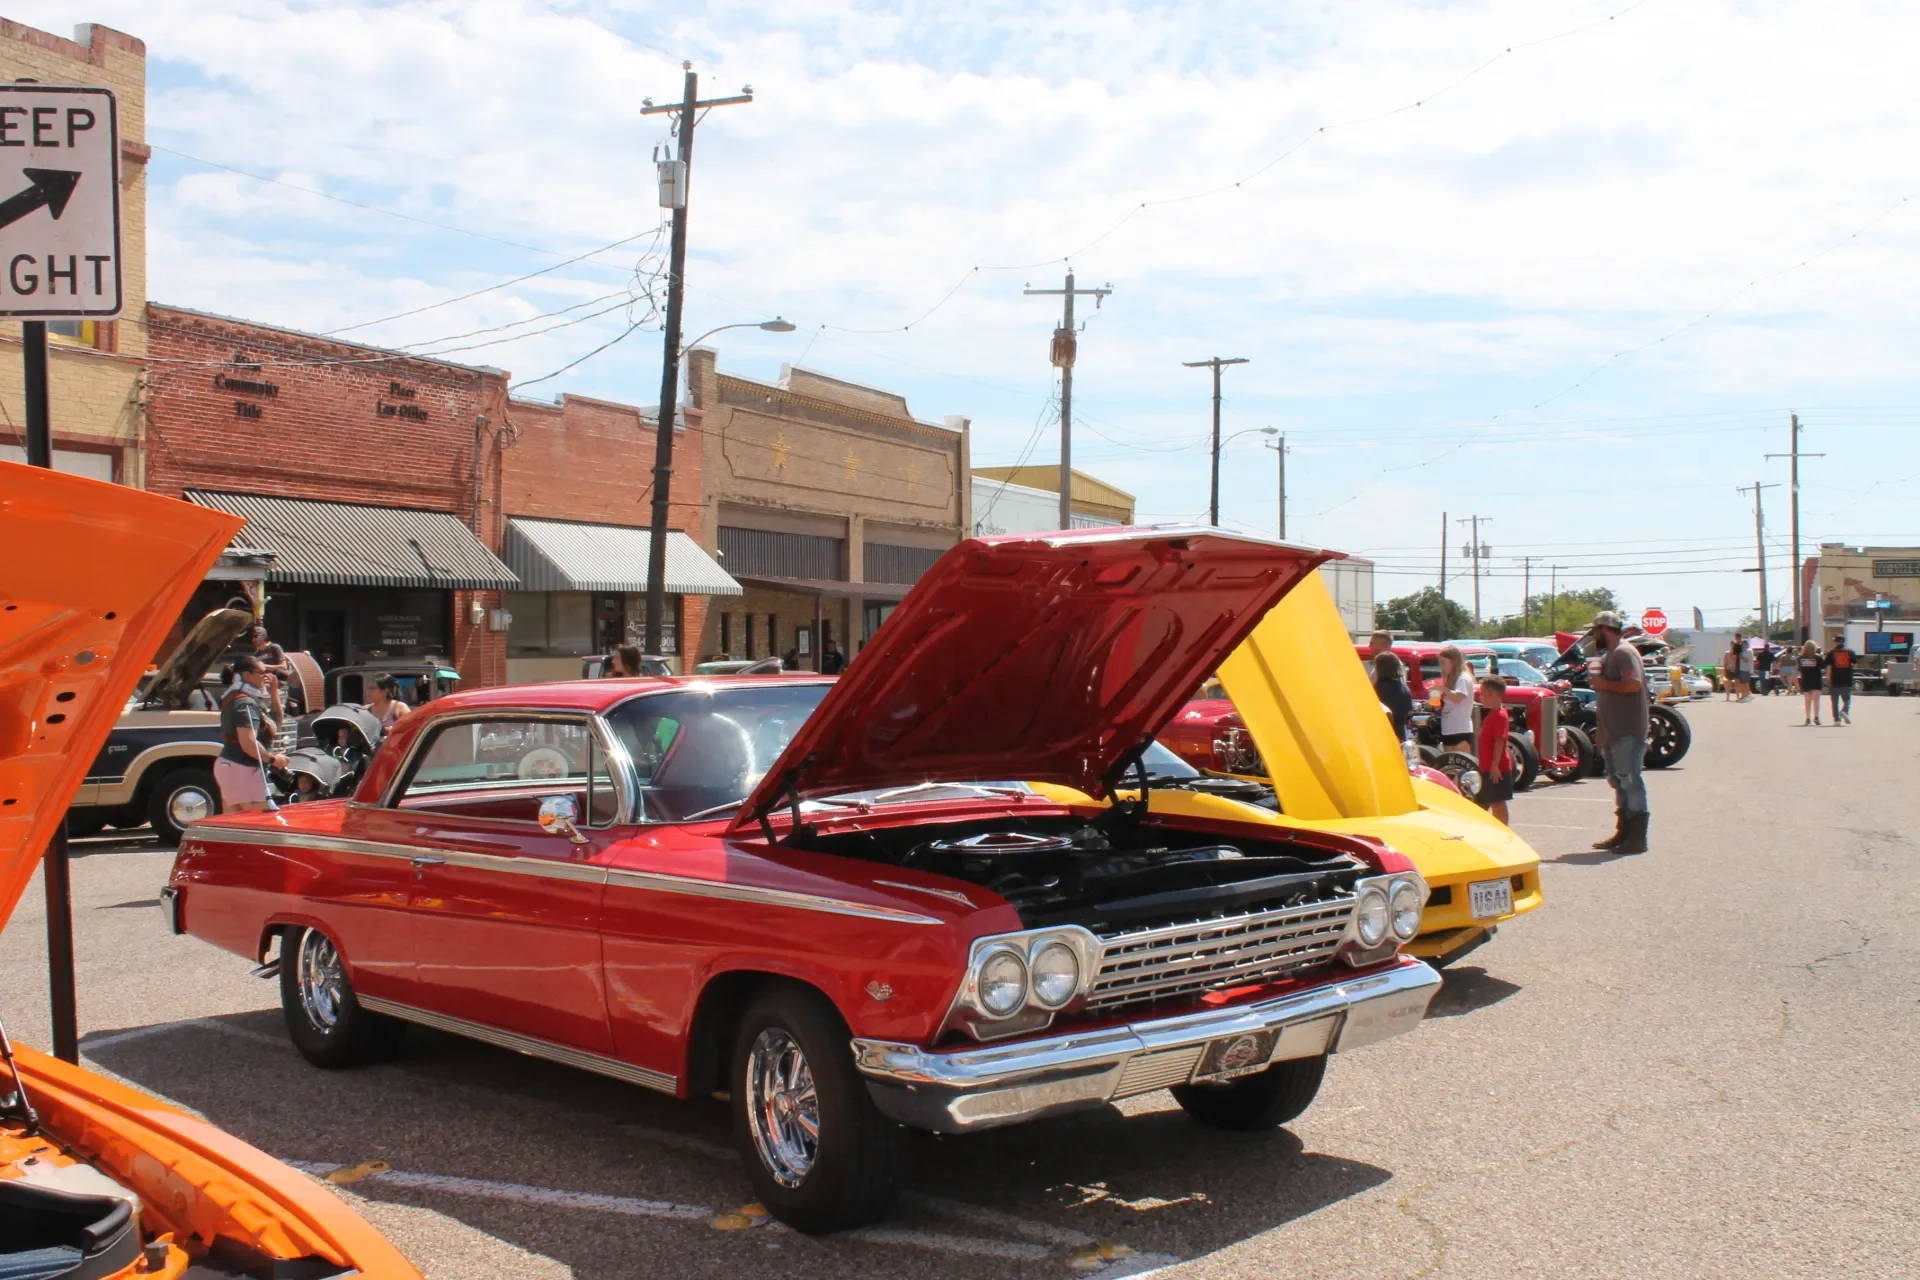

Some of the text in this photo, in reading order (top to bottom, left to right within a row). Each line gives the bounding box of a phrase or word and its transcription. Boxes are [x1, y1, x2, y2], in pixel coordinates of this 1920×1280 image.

[0, 106, 96, 148] EEP
[0, 253, 111, 296] GHT
[214, 372, 279, 397] Community
[390, 382, 415, 397] Place
[234, 401, 261, 418] Title
[400, 404, 428, 420] Office
[1643, 617, 1666, 628] STOP
